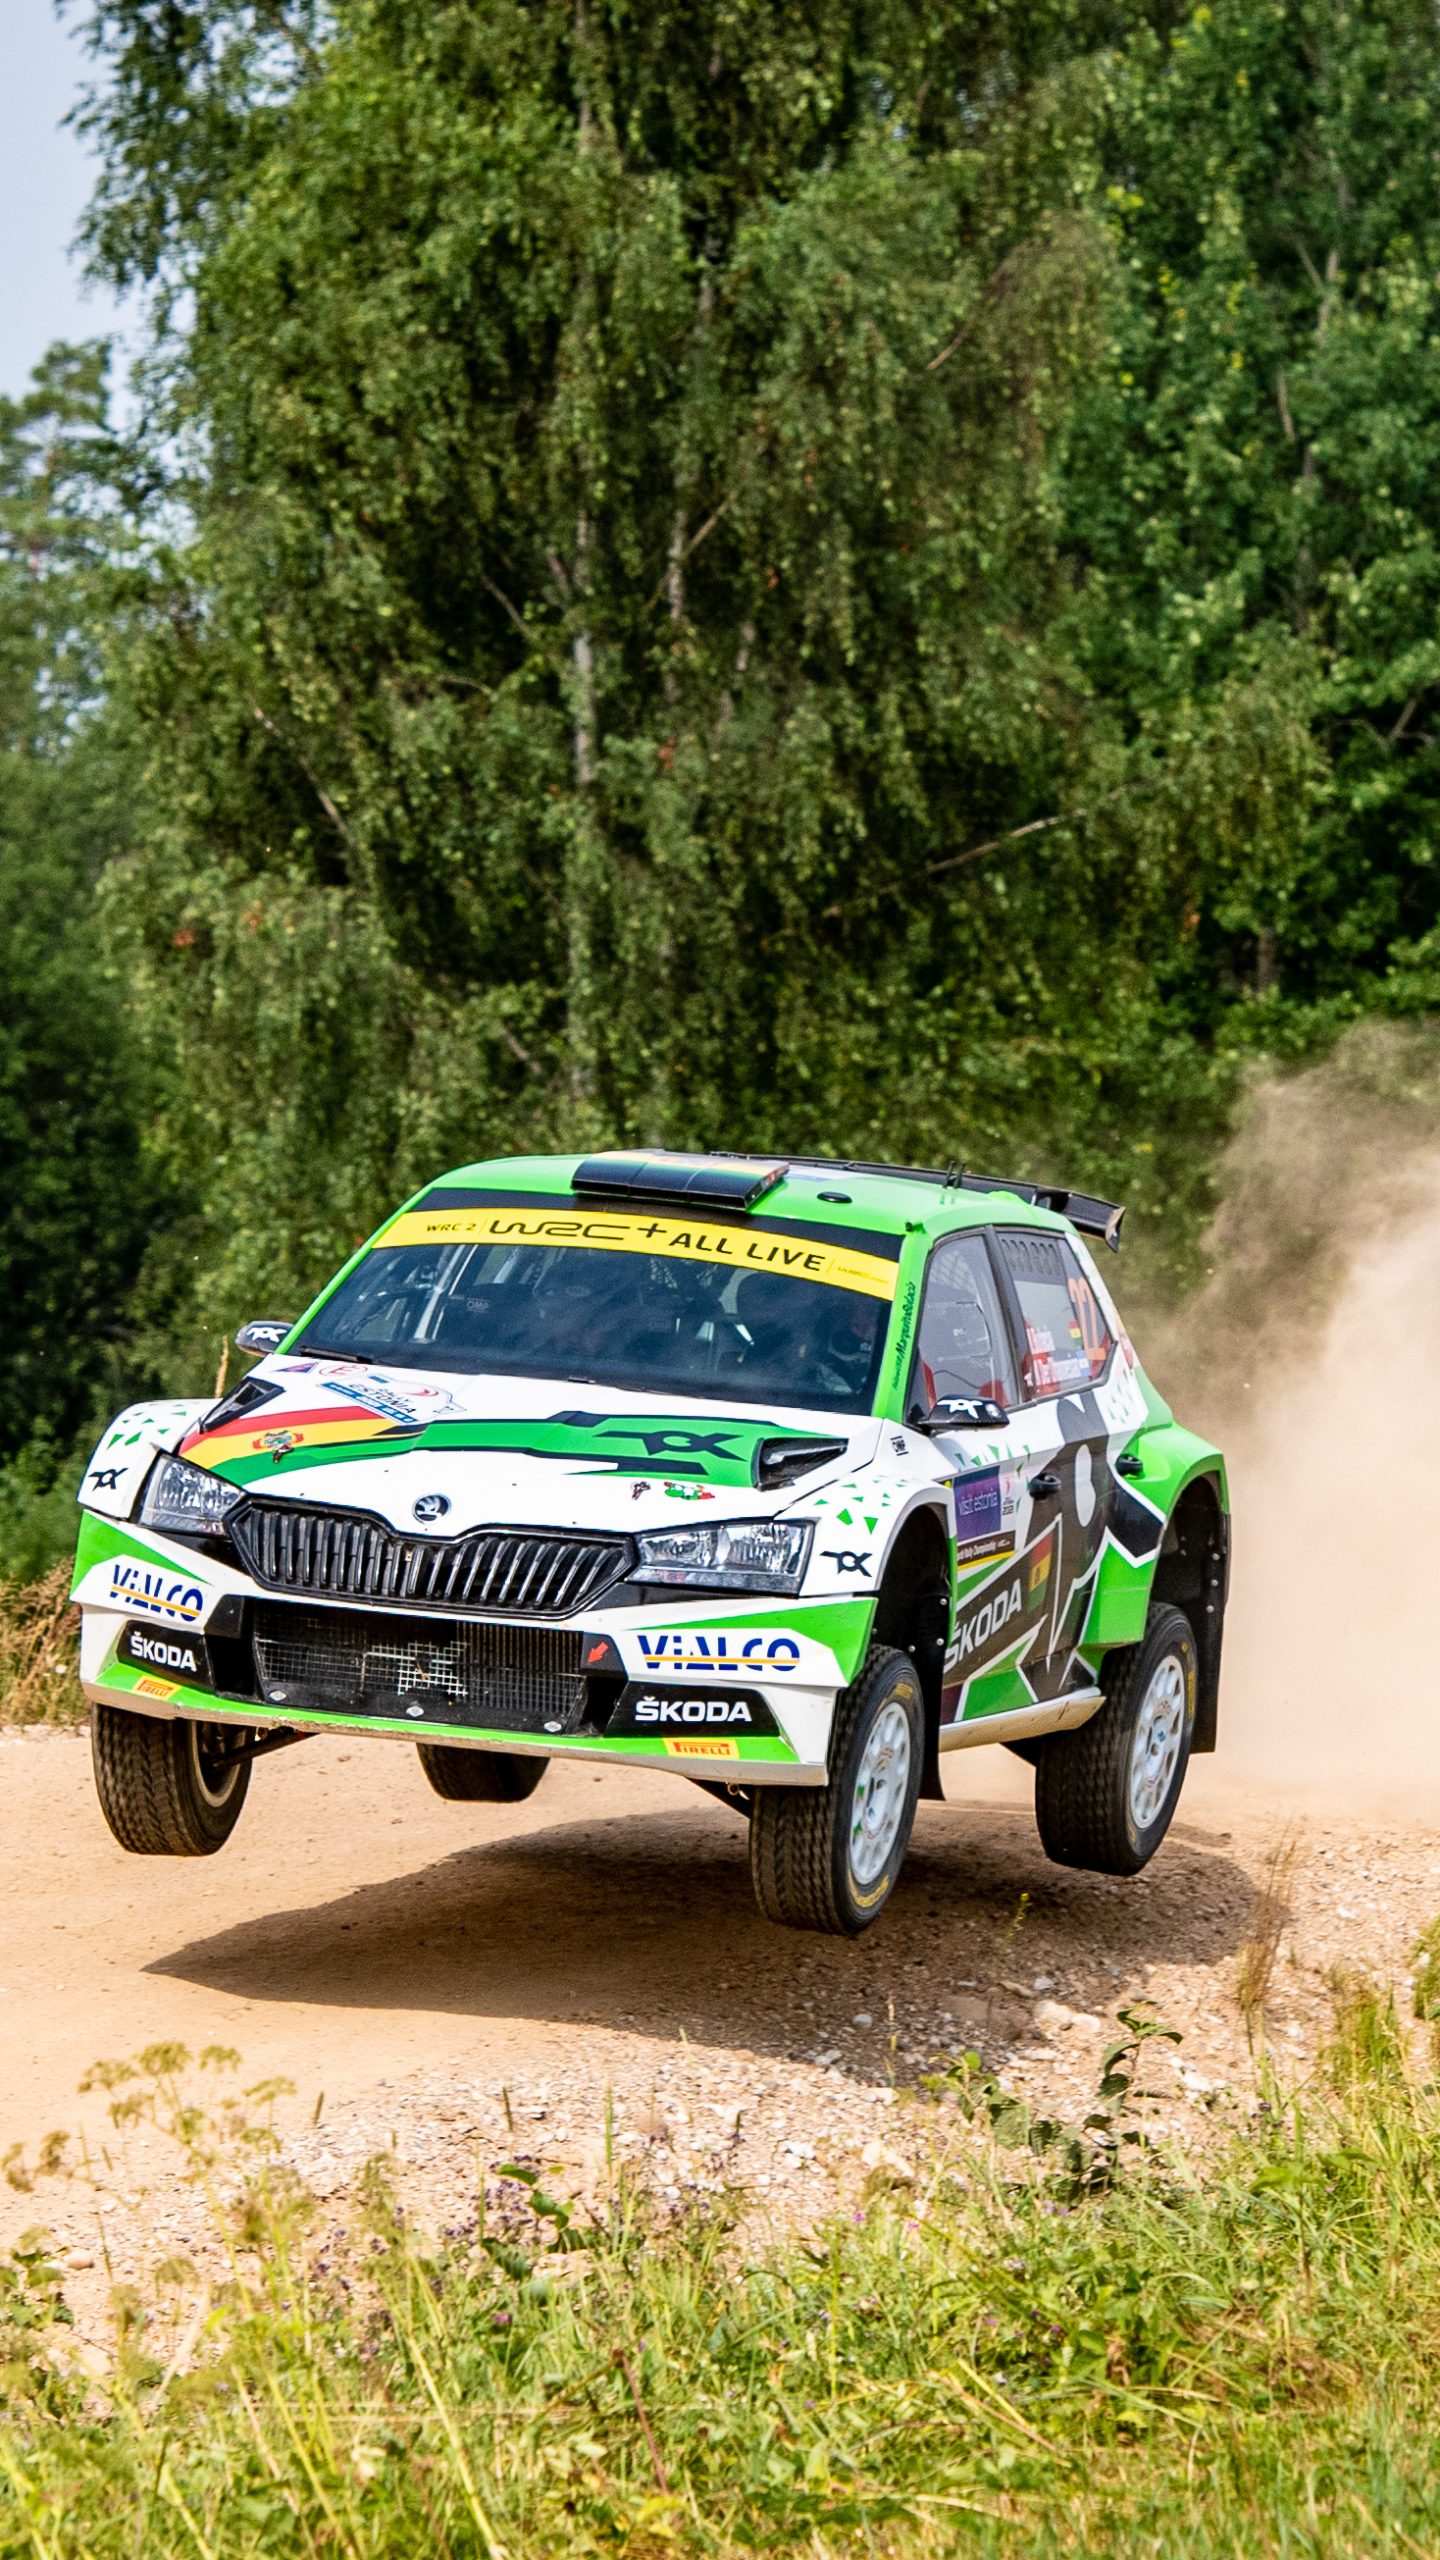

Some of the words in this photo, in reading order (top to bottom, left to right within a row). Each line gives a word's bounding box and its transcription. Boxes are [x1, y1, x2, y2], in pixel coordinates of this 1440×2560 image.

[427, 1223, 458, 1232] WRC
[466, 1223, 477, 1231] 2
[669, 1232, 733, 1255] ALL
[746, 1242, 826, 1272] LIVE
[958, 1495, 974, 1515] visit
[974, 1488, 998, 1511] estonia
[130, 1631, 198, 1672] ŠKODA
[138, 1679, 173, 1698] PIRELLI
[635, 1696, 752, 1722] ŠKODA
[673, 1741, 731, 1756] PIRELLI
